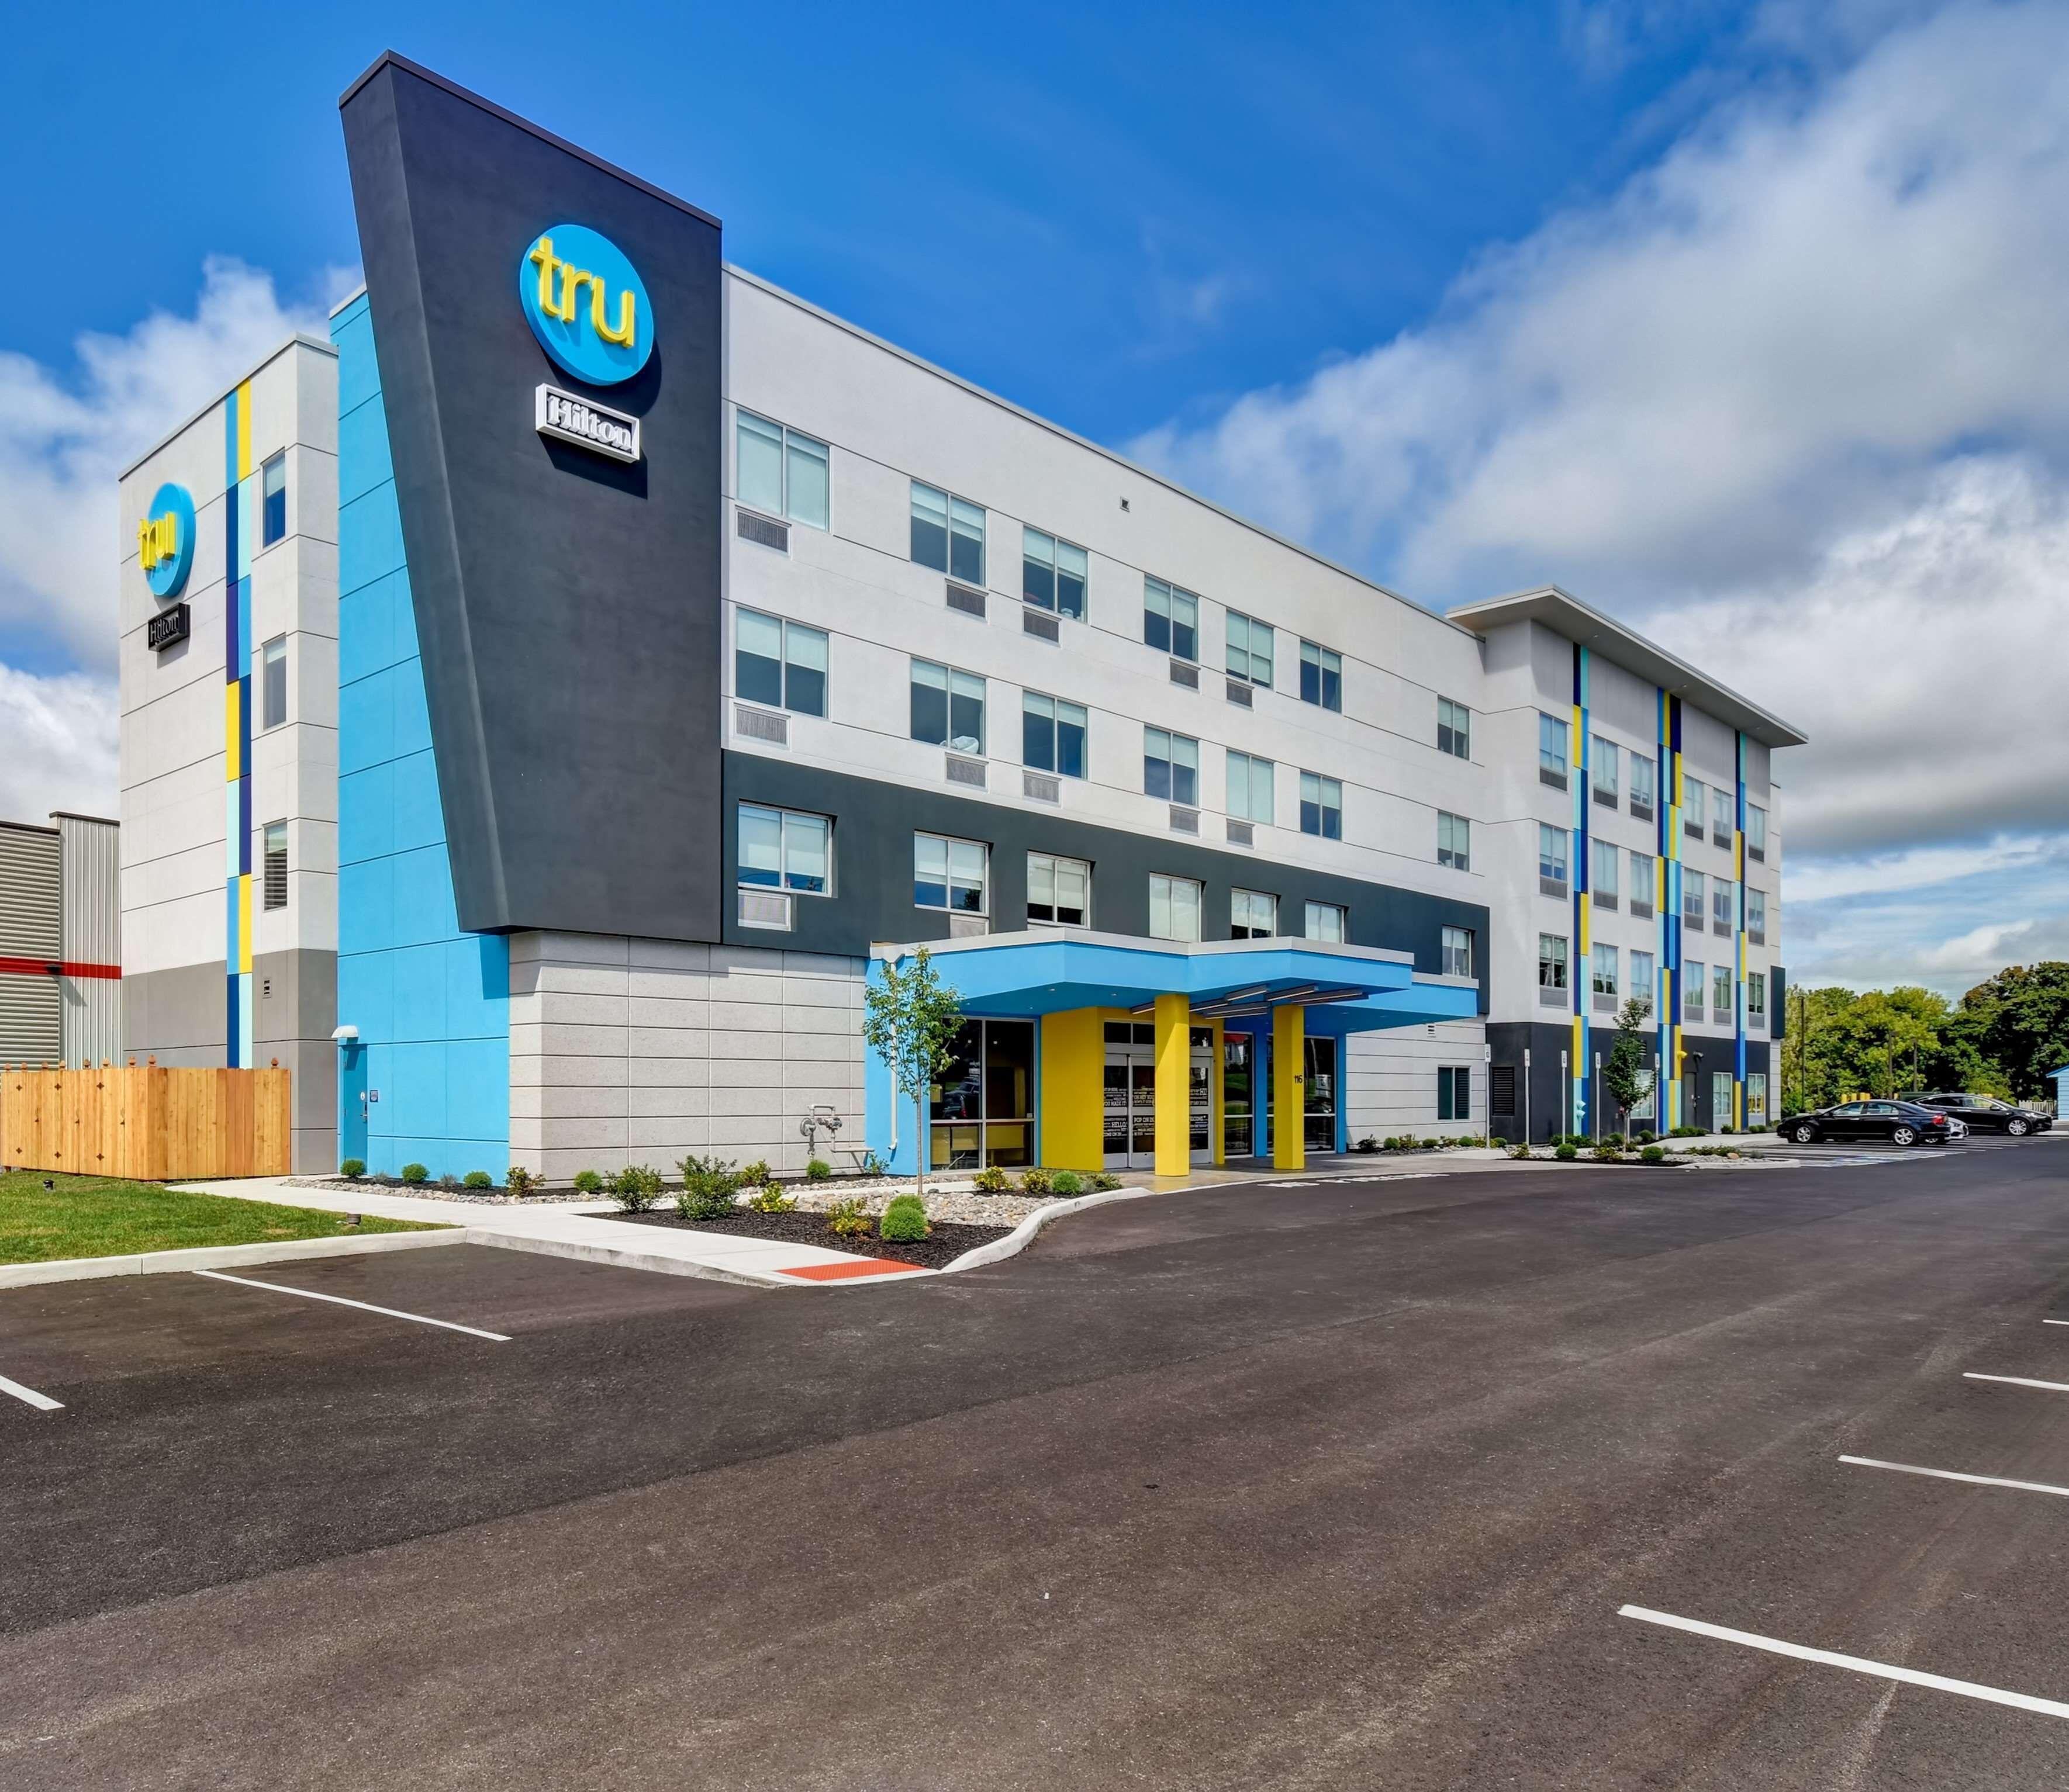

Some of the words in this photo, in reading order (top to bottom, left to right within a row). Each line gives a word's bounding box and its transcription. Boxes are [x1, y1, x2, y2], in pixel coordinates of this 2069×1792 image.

[530, 236, 635, 349] tru
[547, 394, 633, 450] Hilton
[137, 511, 175, 570] tru
[150, 617, 178, 644] Hilton
[1294, 1074, 1303, 1084] 116
